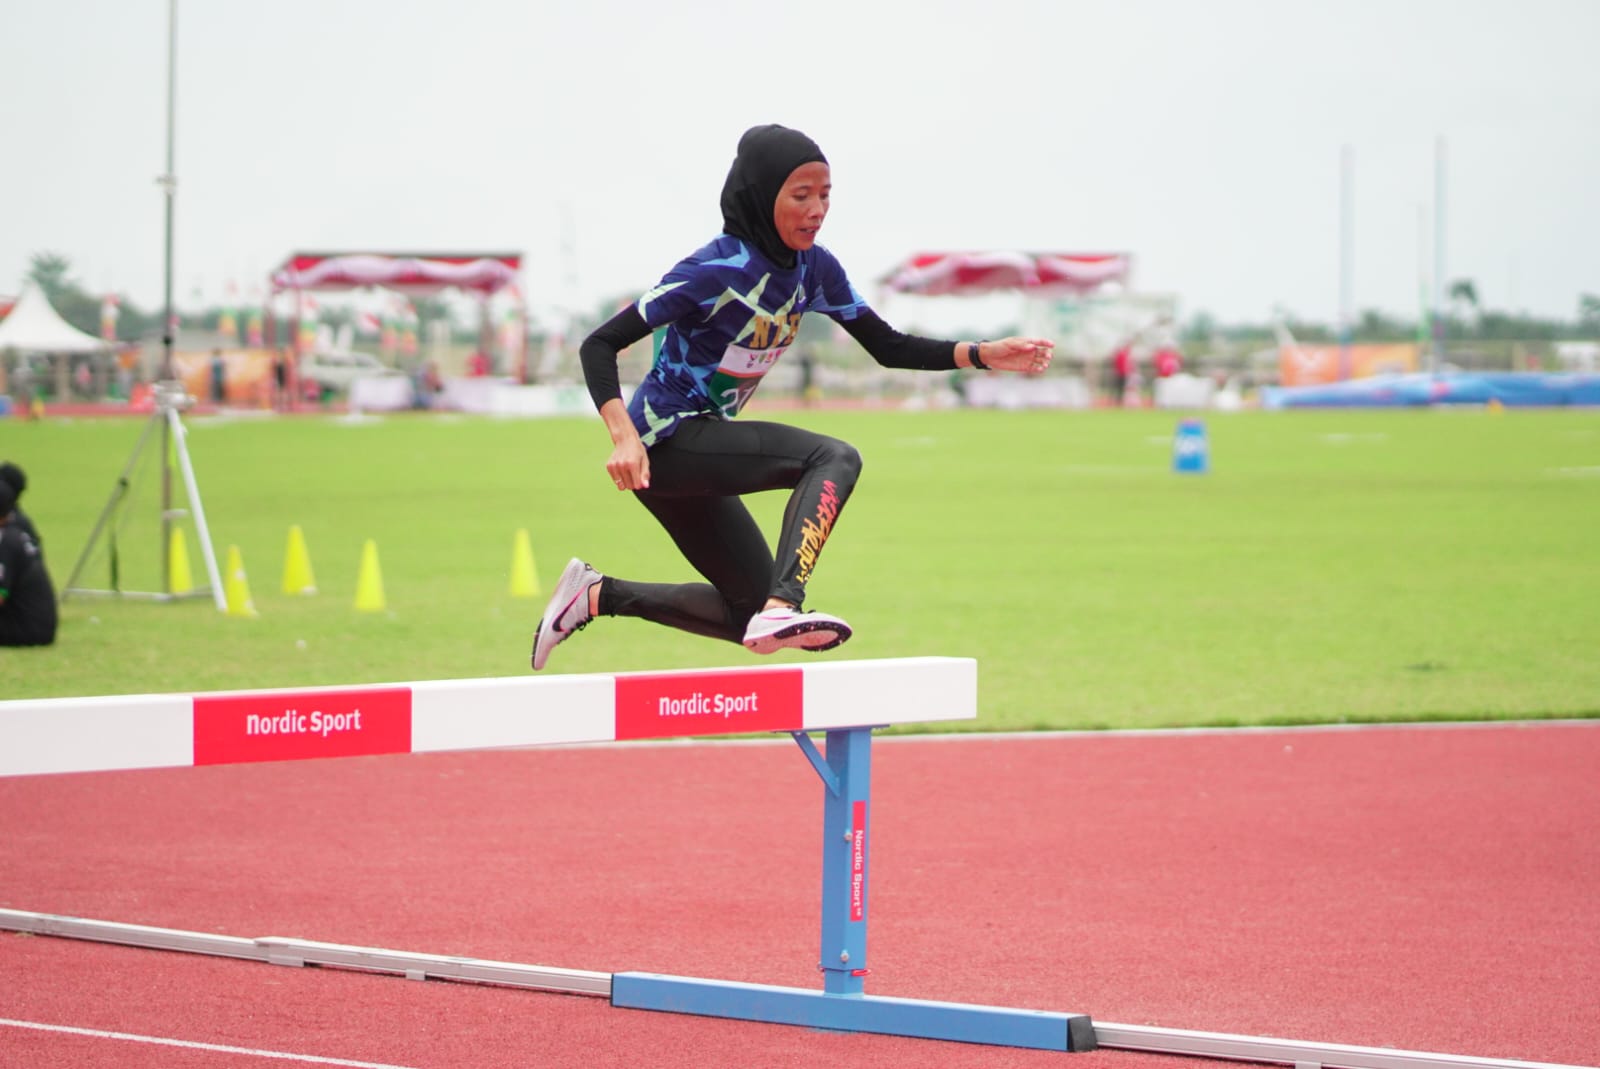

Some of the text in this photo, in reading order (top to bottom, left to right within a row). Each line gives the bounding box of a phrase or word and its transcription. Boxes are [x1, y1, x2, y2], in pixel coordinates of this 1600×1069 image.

[713, 692, 758, 718] Sport
[310, 709, 361, 737] Sport
[854, 829, 864, 870] Nordic
[852, 873, 862, 906] Sport
